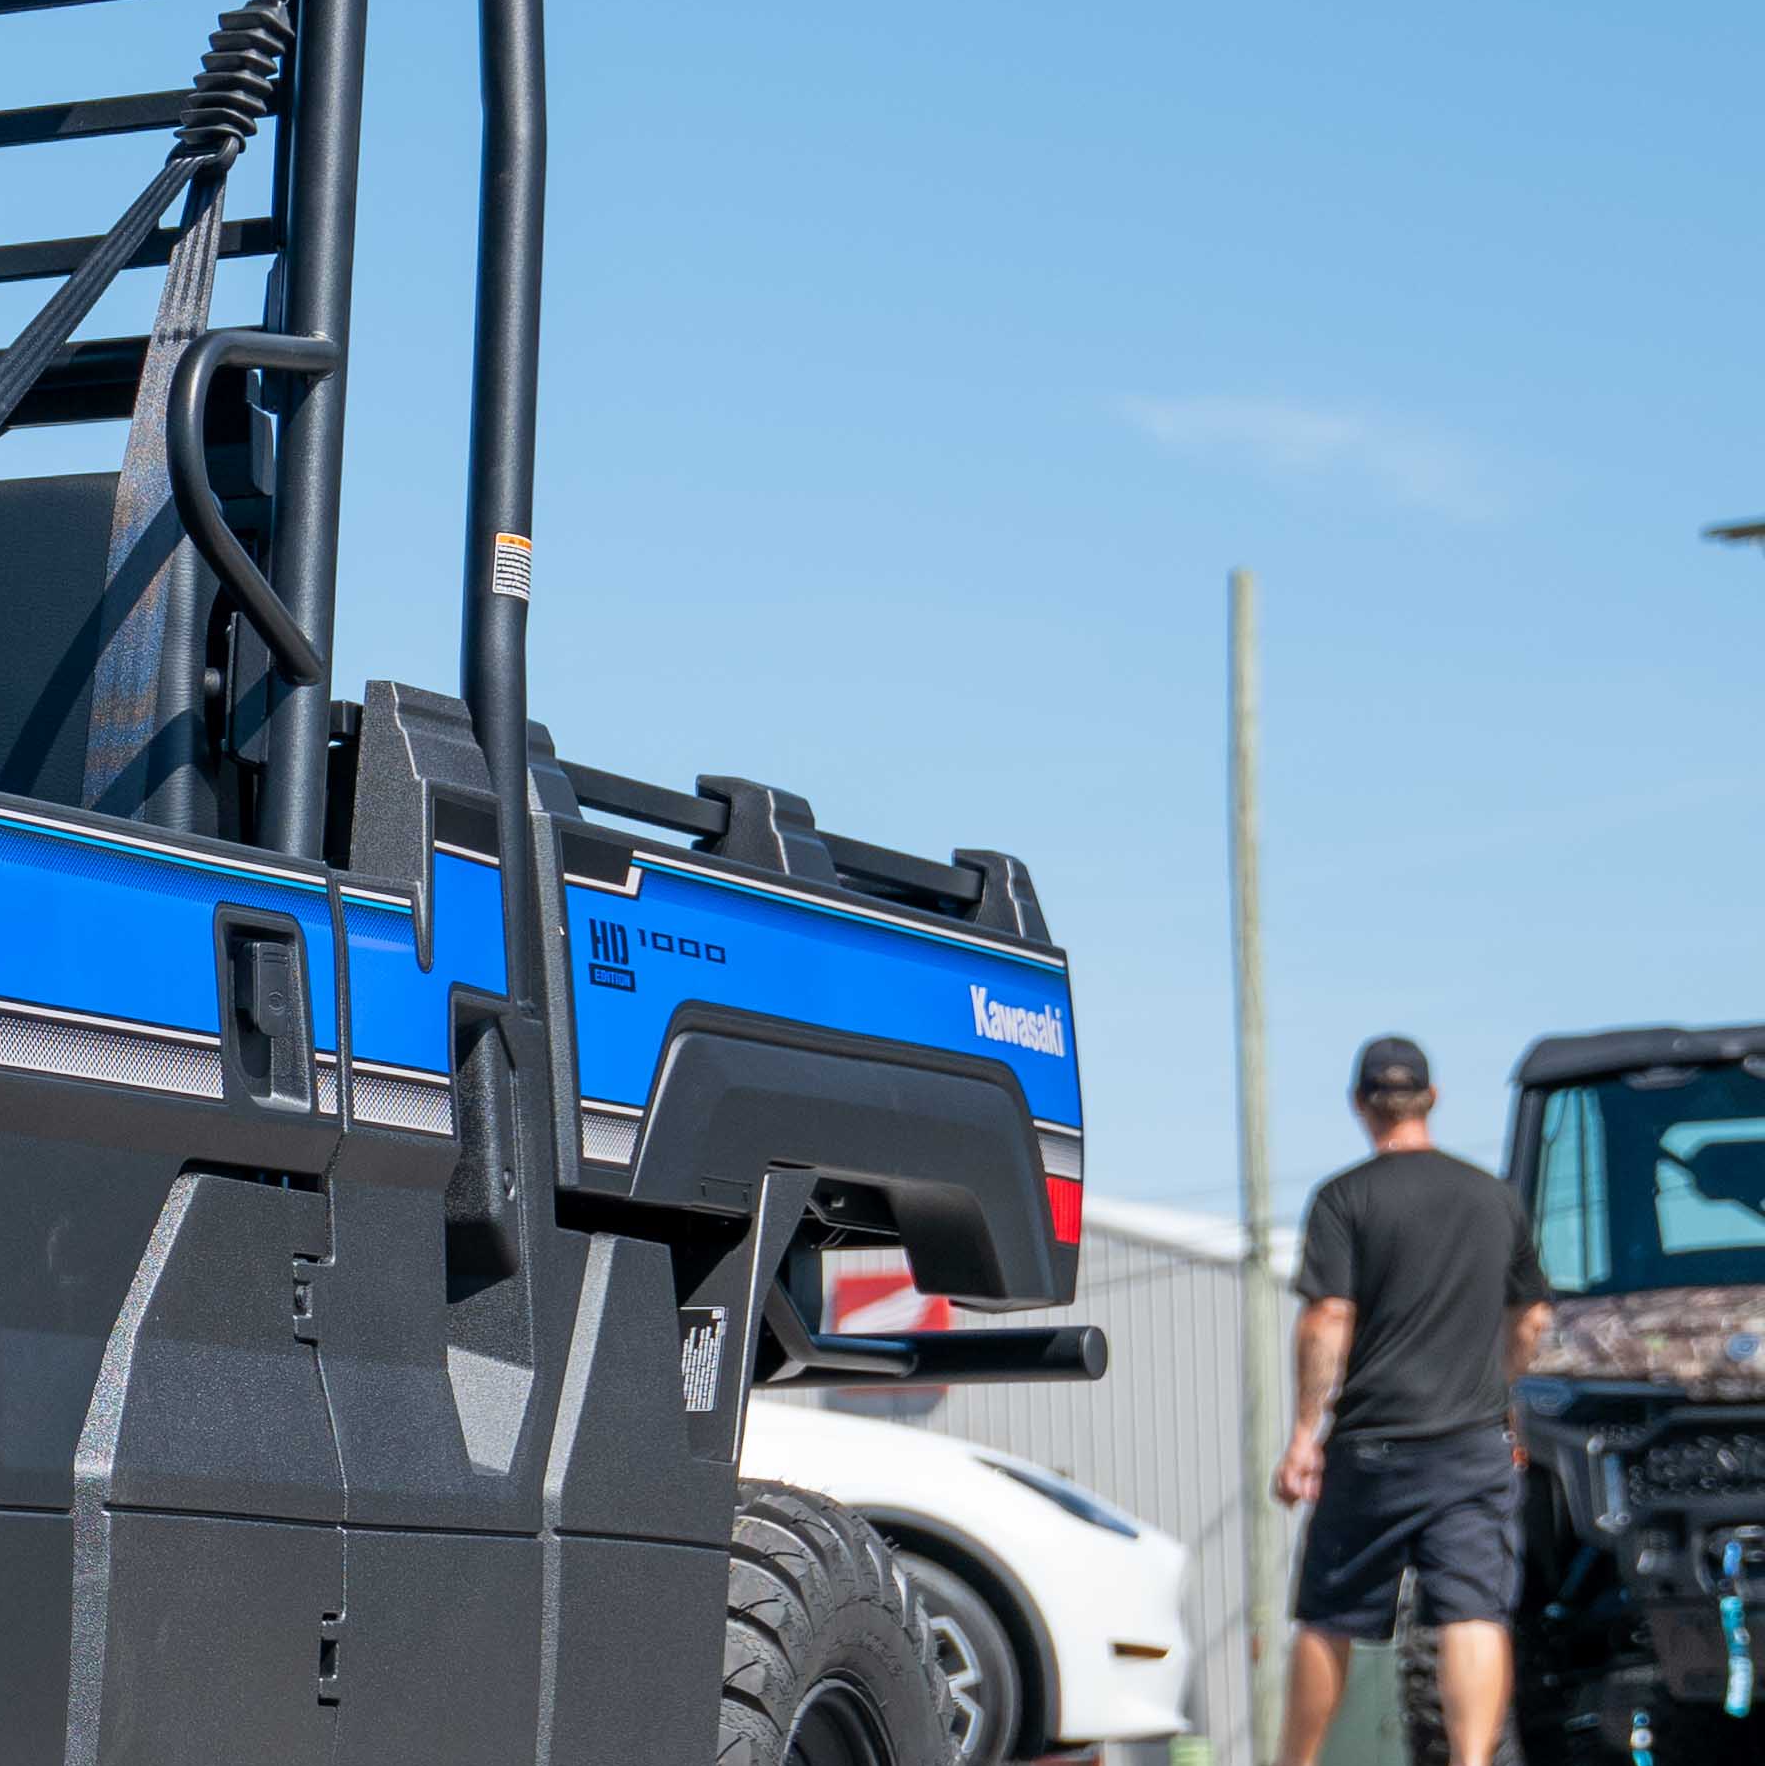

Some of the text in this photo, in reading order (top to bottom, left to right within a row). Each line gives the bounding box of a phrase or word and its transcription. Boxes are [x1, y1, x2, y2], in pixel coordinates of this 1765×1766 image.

[589, 918, 726, 965] HD 1000
[970, 985, 1064, 1058] Kawasaki
